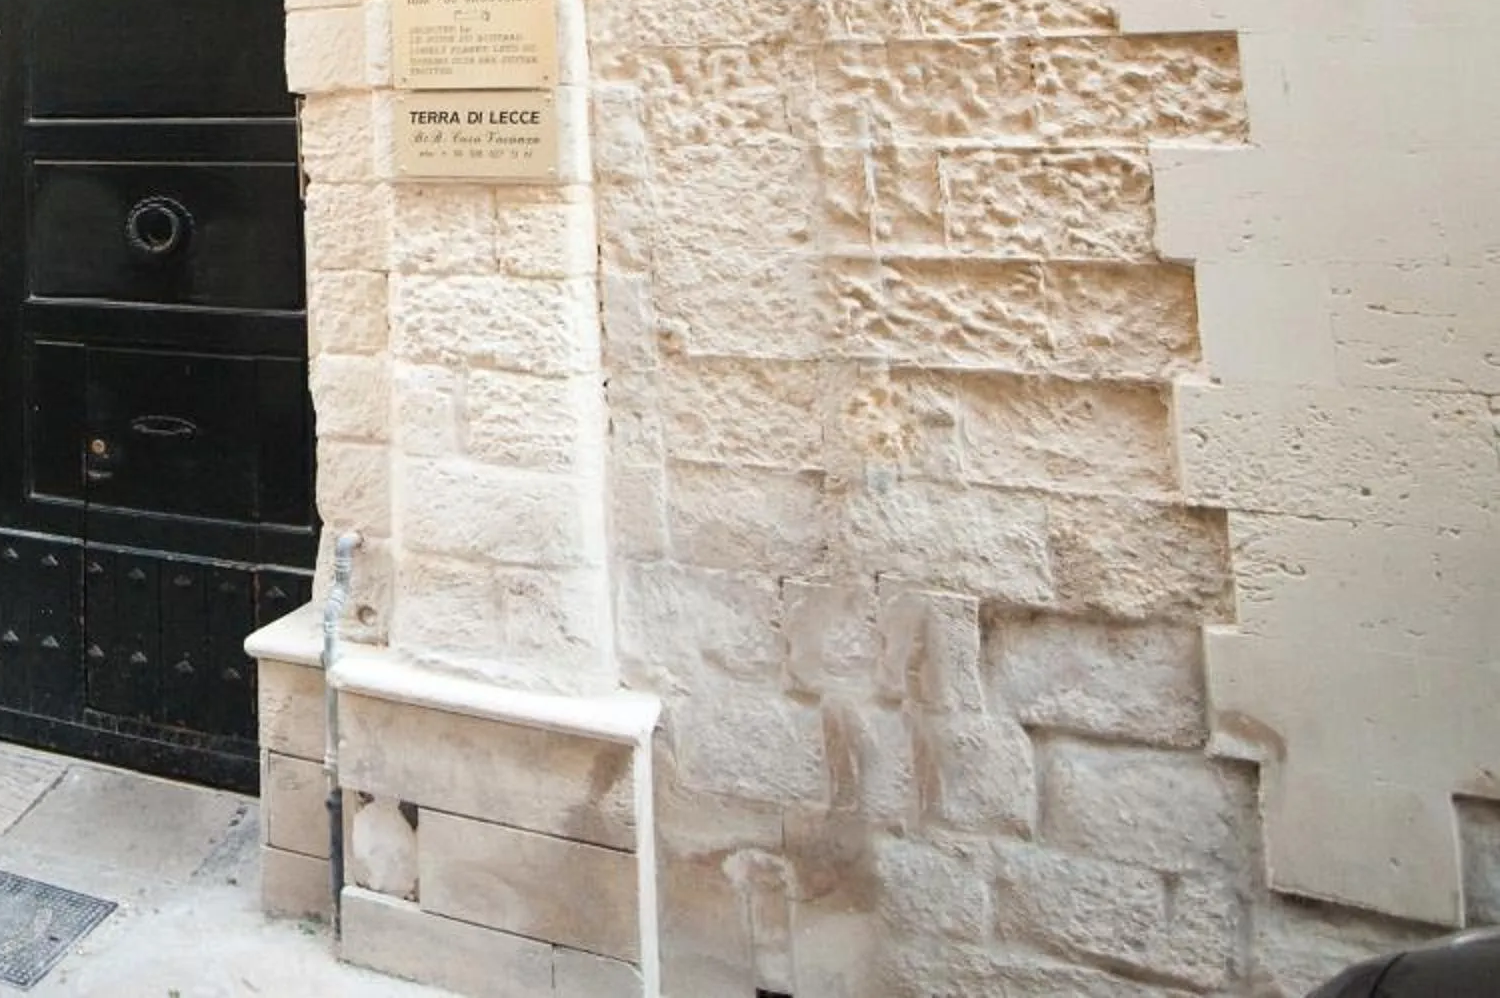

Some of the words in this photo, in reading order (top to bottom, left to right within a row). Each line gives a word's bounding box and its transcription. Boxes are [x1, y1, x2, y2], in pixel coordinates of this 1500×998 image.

[409, 111, 460, 124] TERRA
[467, 111, 483, 124] DI
[489, 111, 541, 124] LECCE
